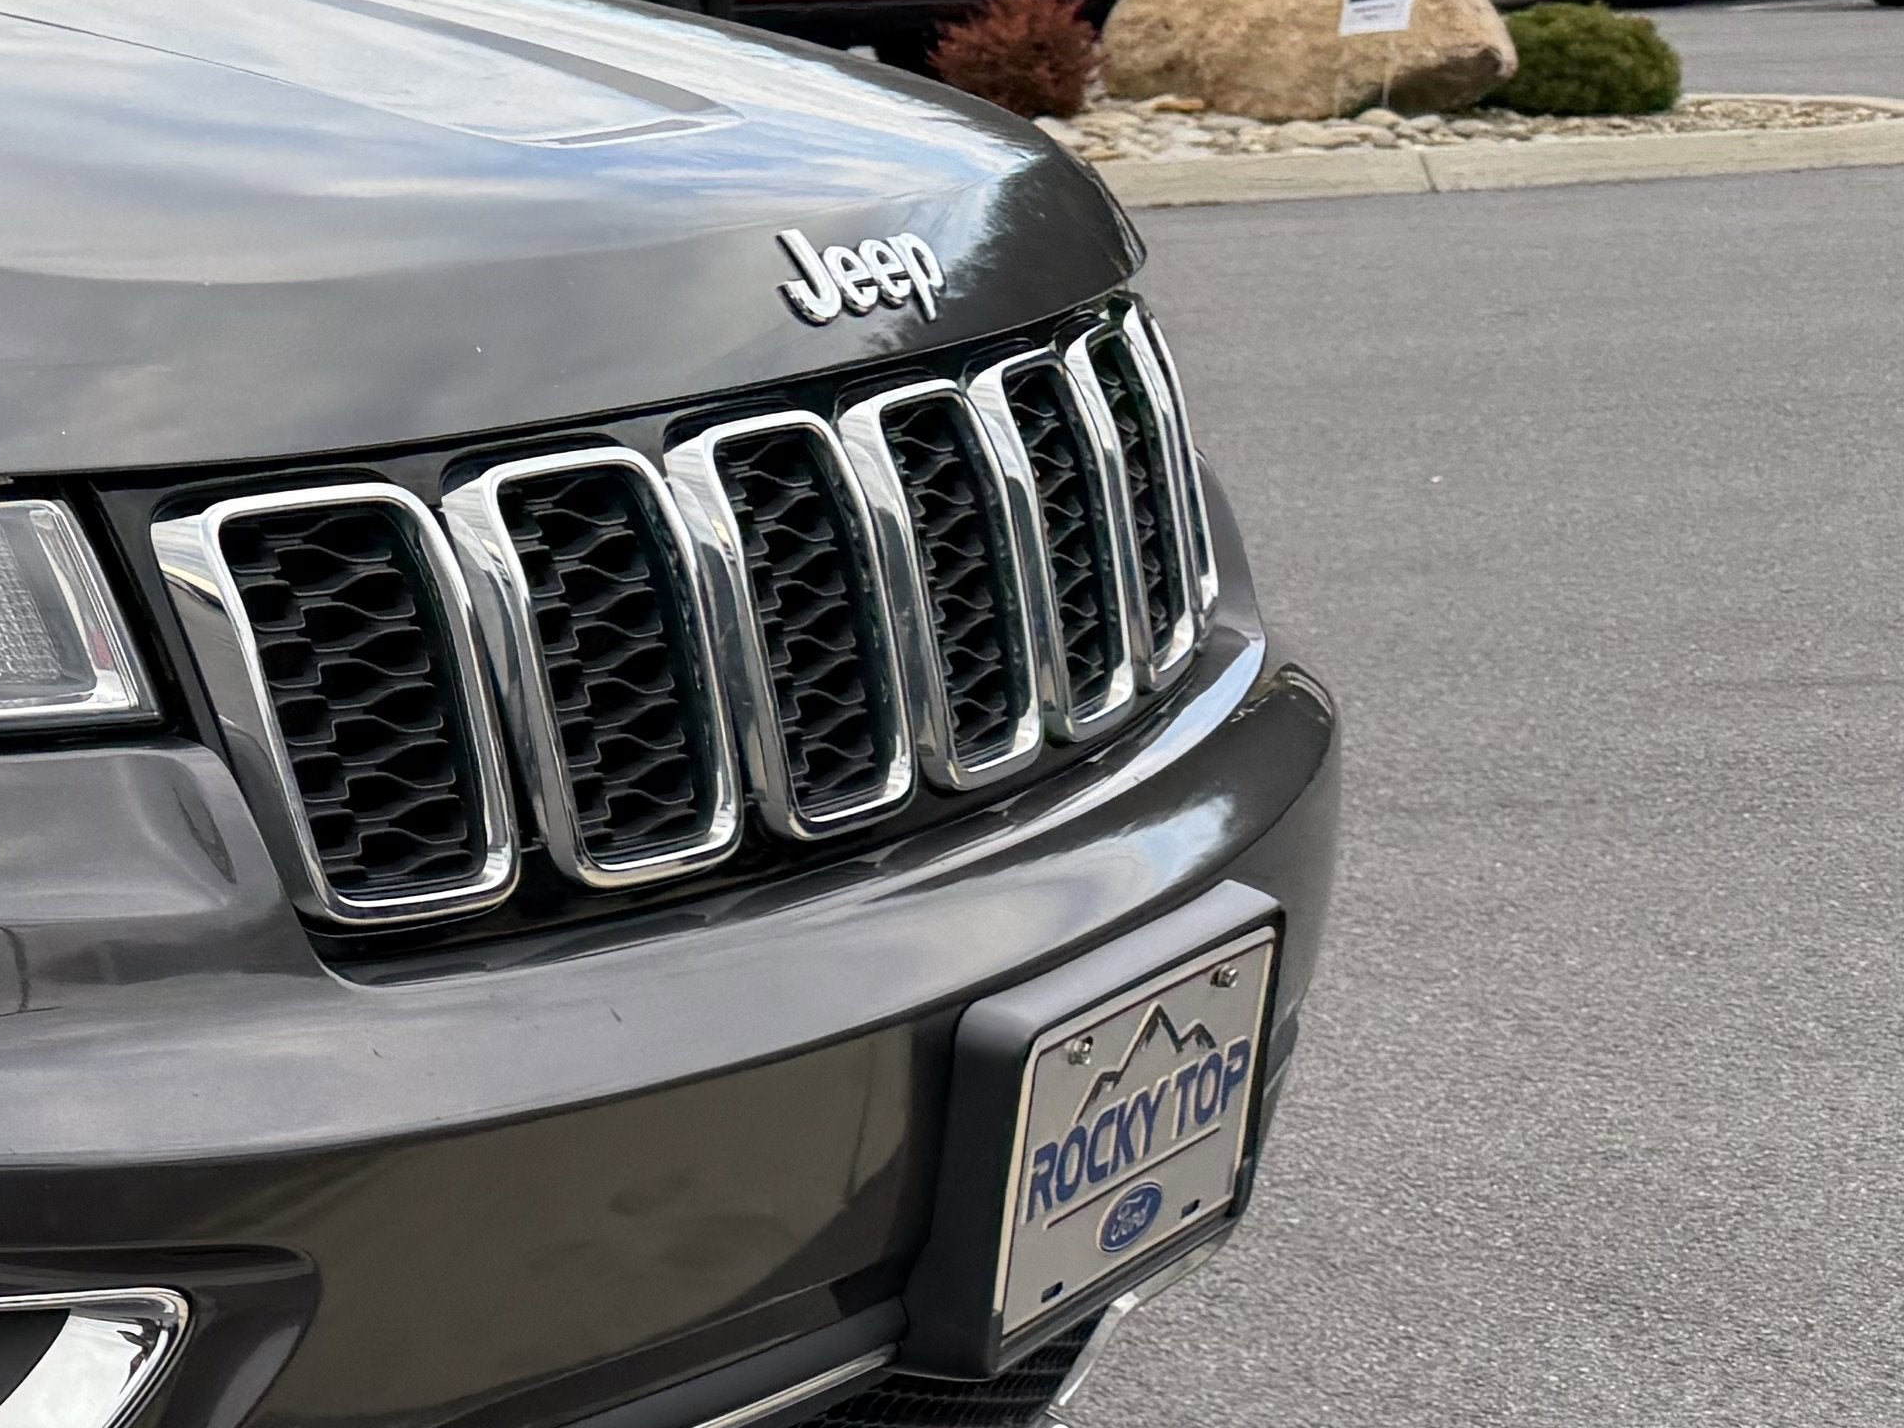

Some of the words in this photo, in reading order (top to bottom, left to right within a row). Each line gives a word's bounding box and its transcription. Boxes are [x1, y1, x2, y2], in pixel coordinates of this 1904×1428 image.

[776, 227, 945, 326] Jeep
[1021, 1076, 1171, 1225] ROCKY
[1170, 1035, 1252, 1141] TOP
